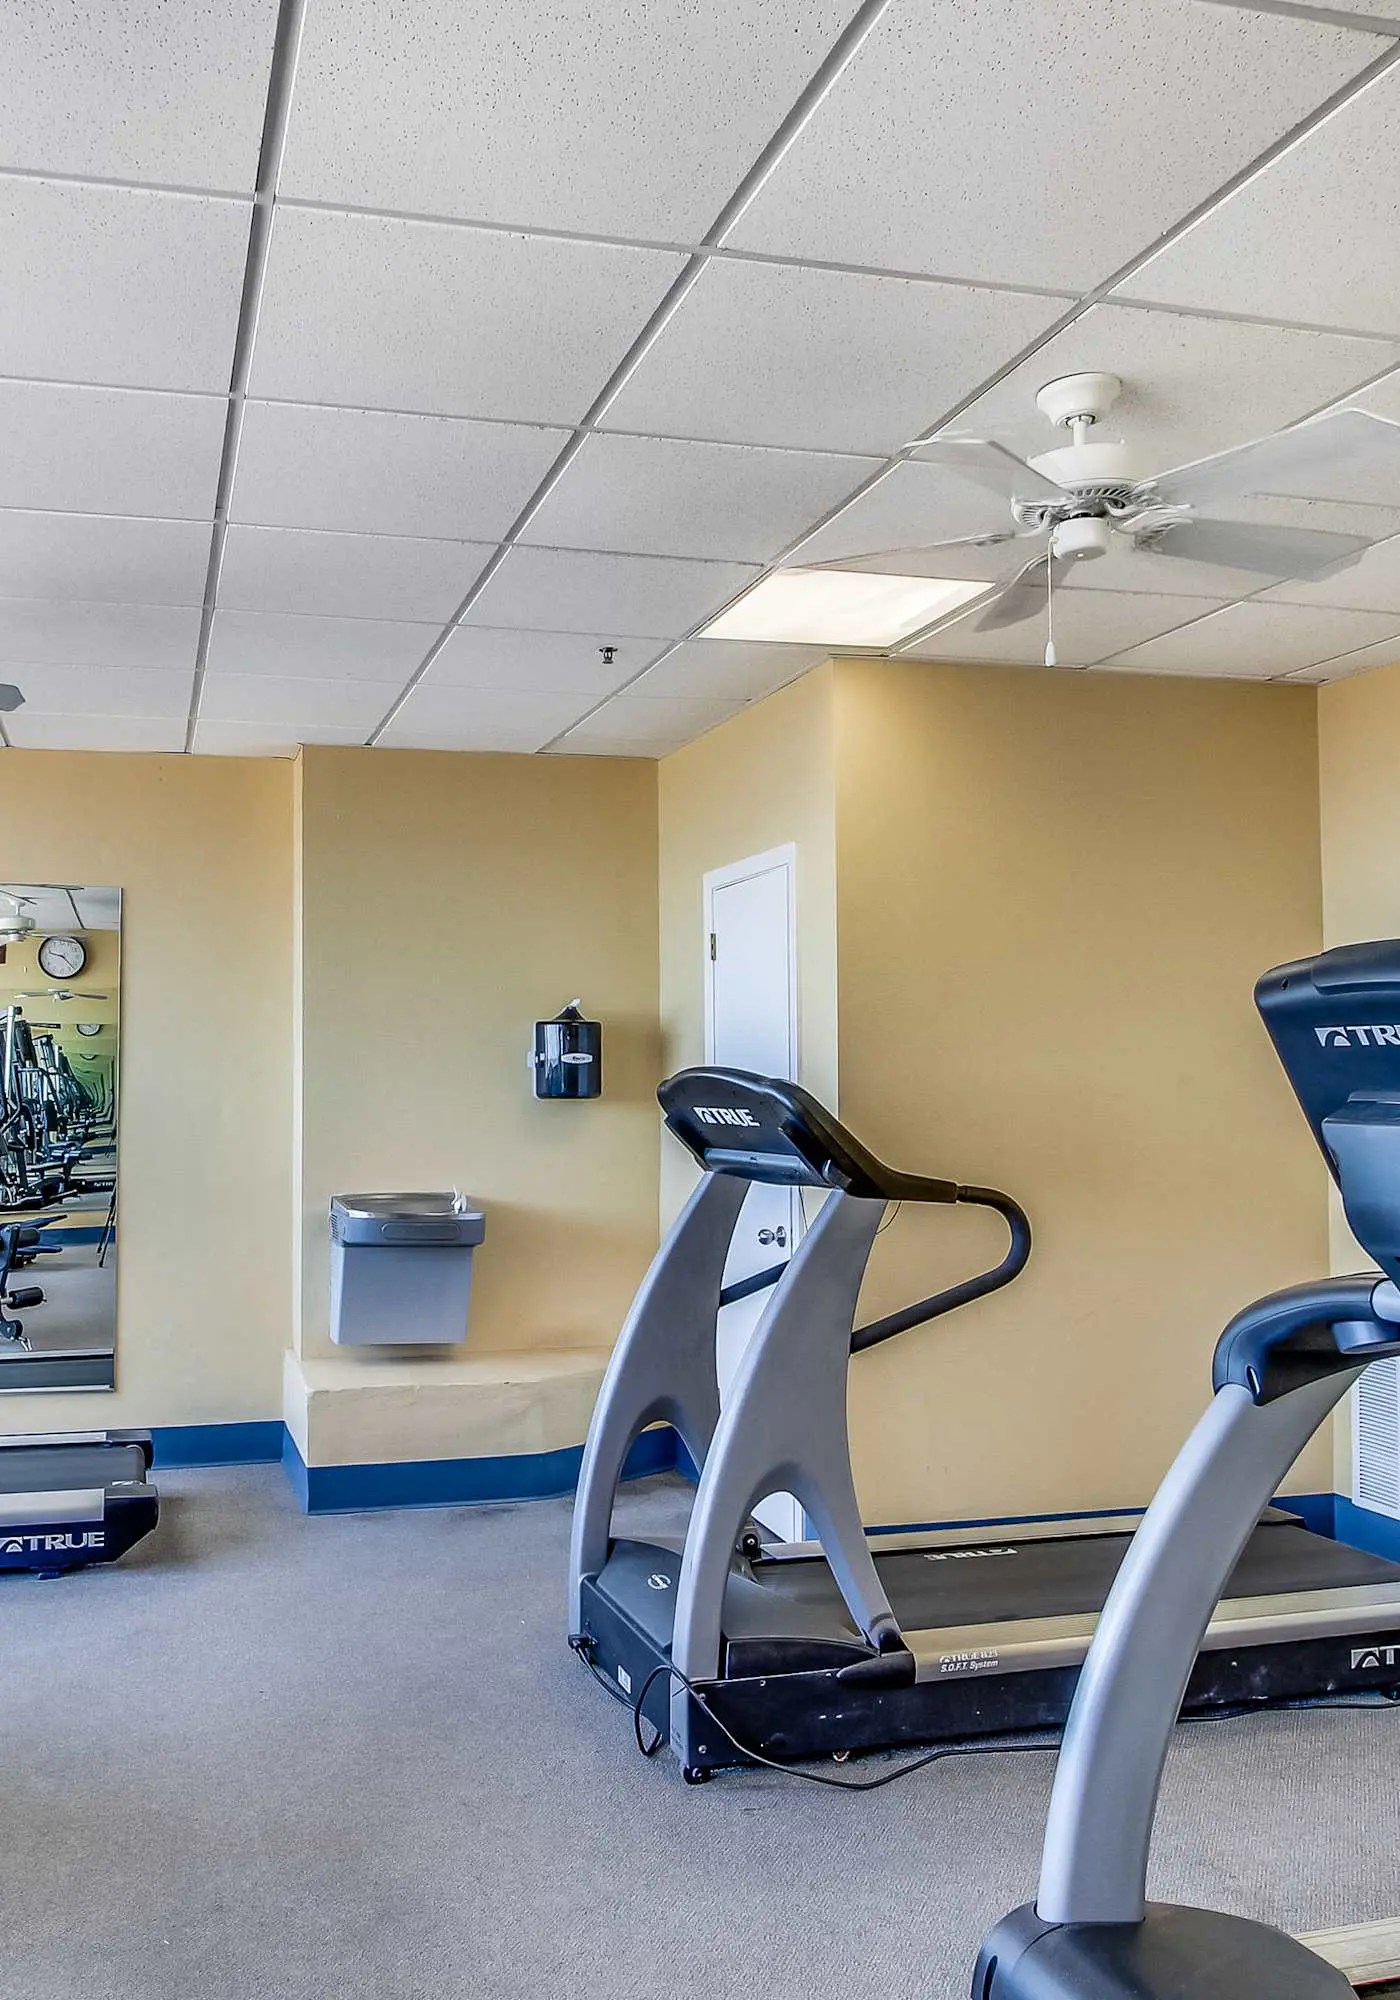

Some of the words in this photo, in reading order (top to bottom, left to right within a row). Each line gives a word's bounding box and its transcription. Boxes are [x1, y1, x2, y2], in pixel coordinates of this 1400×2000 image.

[707, 1107, 760, 1127] TRUE
[23, 1531, 105, 1551] TRUE
[969, 1660, 999, 1671] System
